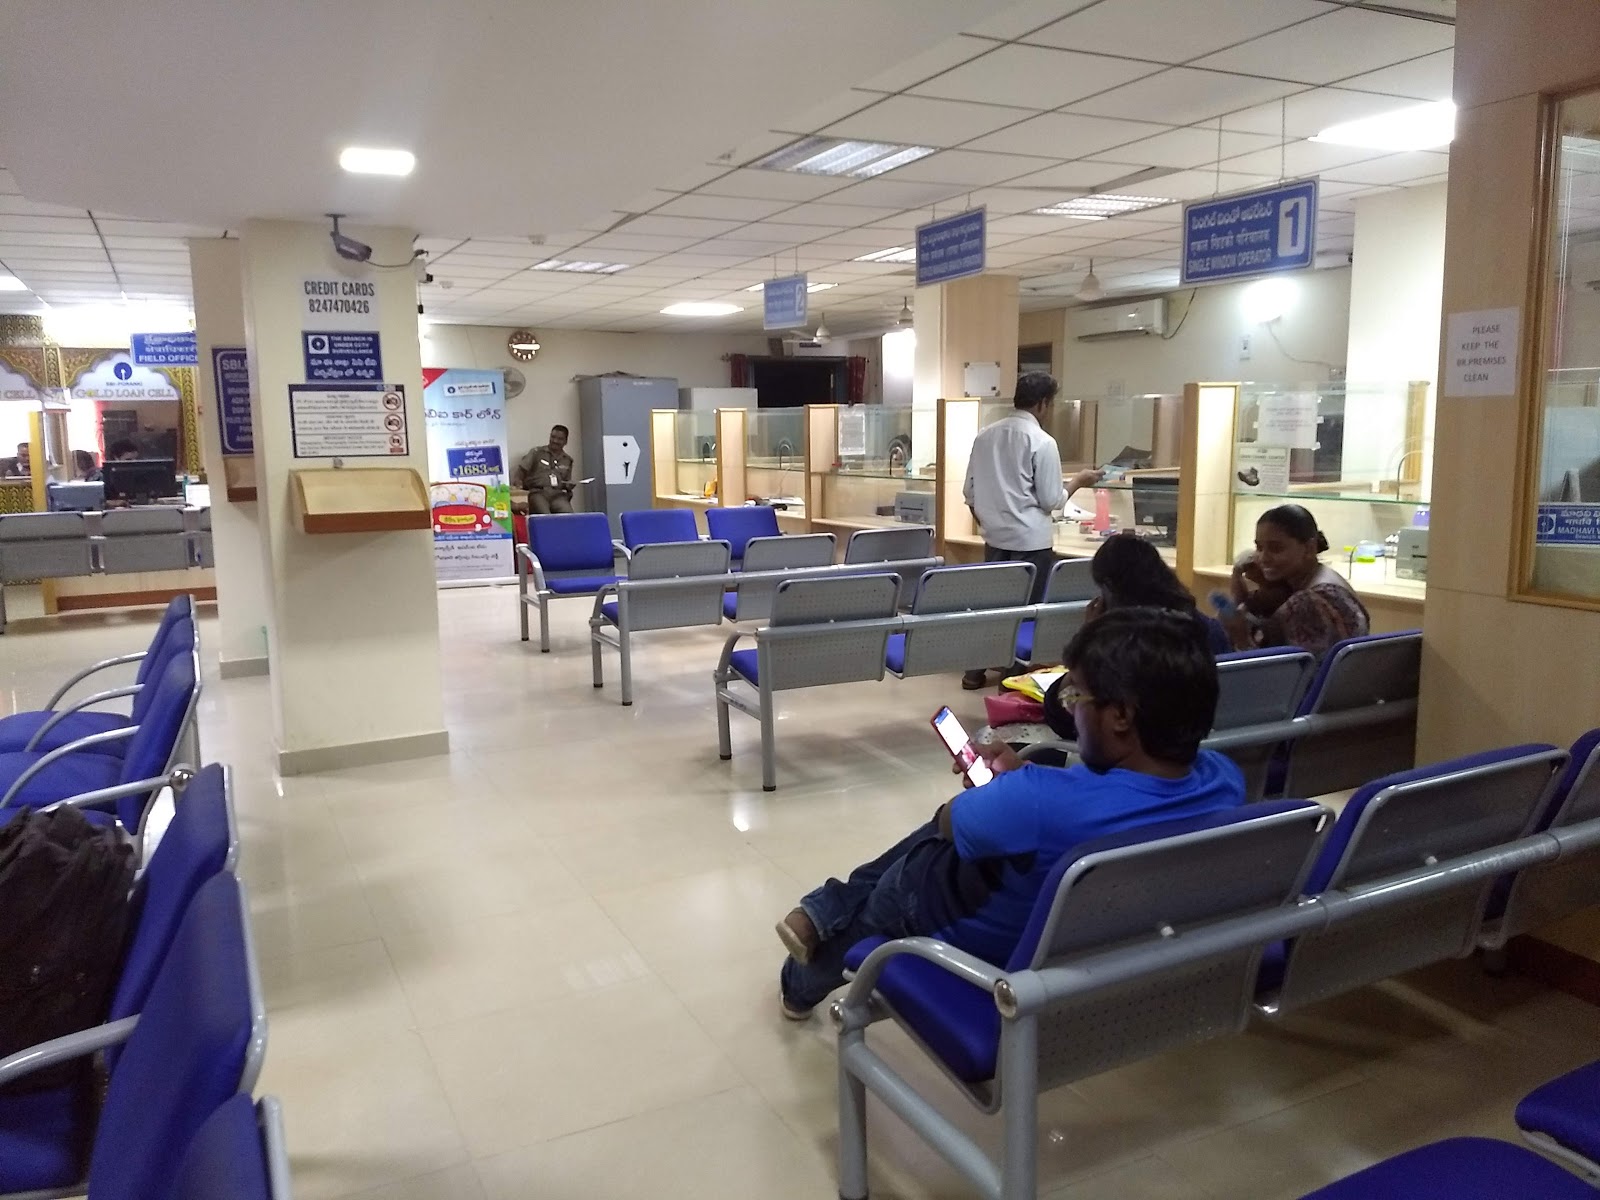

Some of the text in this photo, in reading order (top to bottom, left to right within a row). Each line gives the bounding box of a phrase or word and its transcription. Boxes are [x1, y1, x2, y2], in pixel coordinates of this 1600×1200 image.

[1285, 201, 1299, 248] 1
[1188, 248, 1271, 274] SINGLE WINDOW OPERATOR
[304, 281, 375, 296] CREDIT CARDS
[308, 299, 370, 314] 8247470426
[1472, 324, 1500, 334] PLEASE
[1461, 340, 1499, 351] KEEP THE
[167, 354, 198, 362] OFFIC
[1463, 373, 1489, 382] CLEAN
[5, 389, 37, 399] CELL
[116, 389, 146, 398] LOAN
[147, 389, 174, 398] CELL
[1557, 526, 1595, 534] MADHAVI
